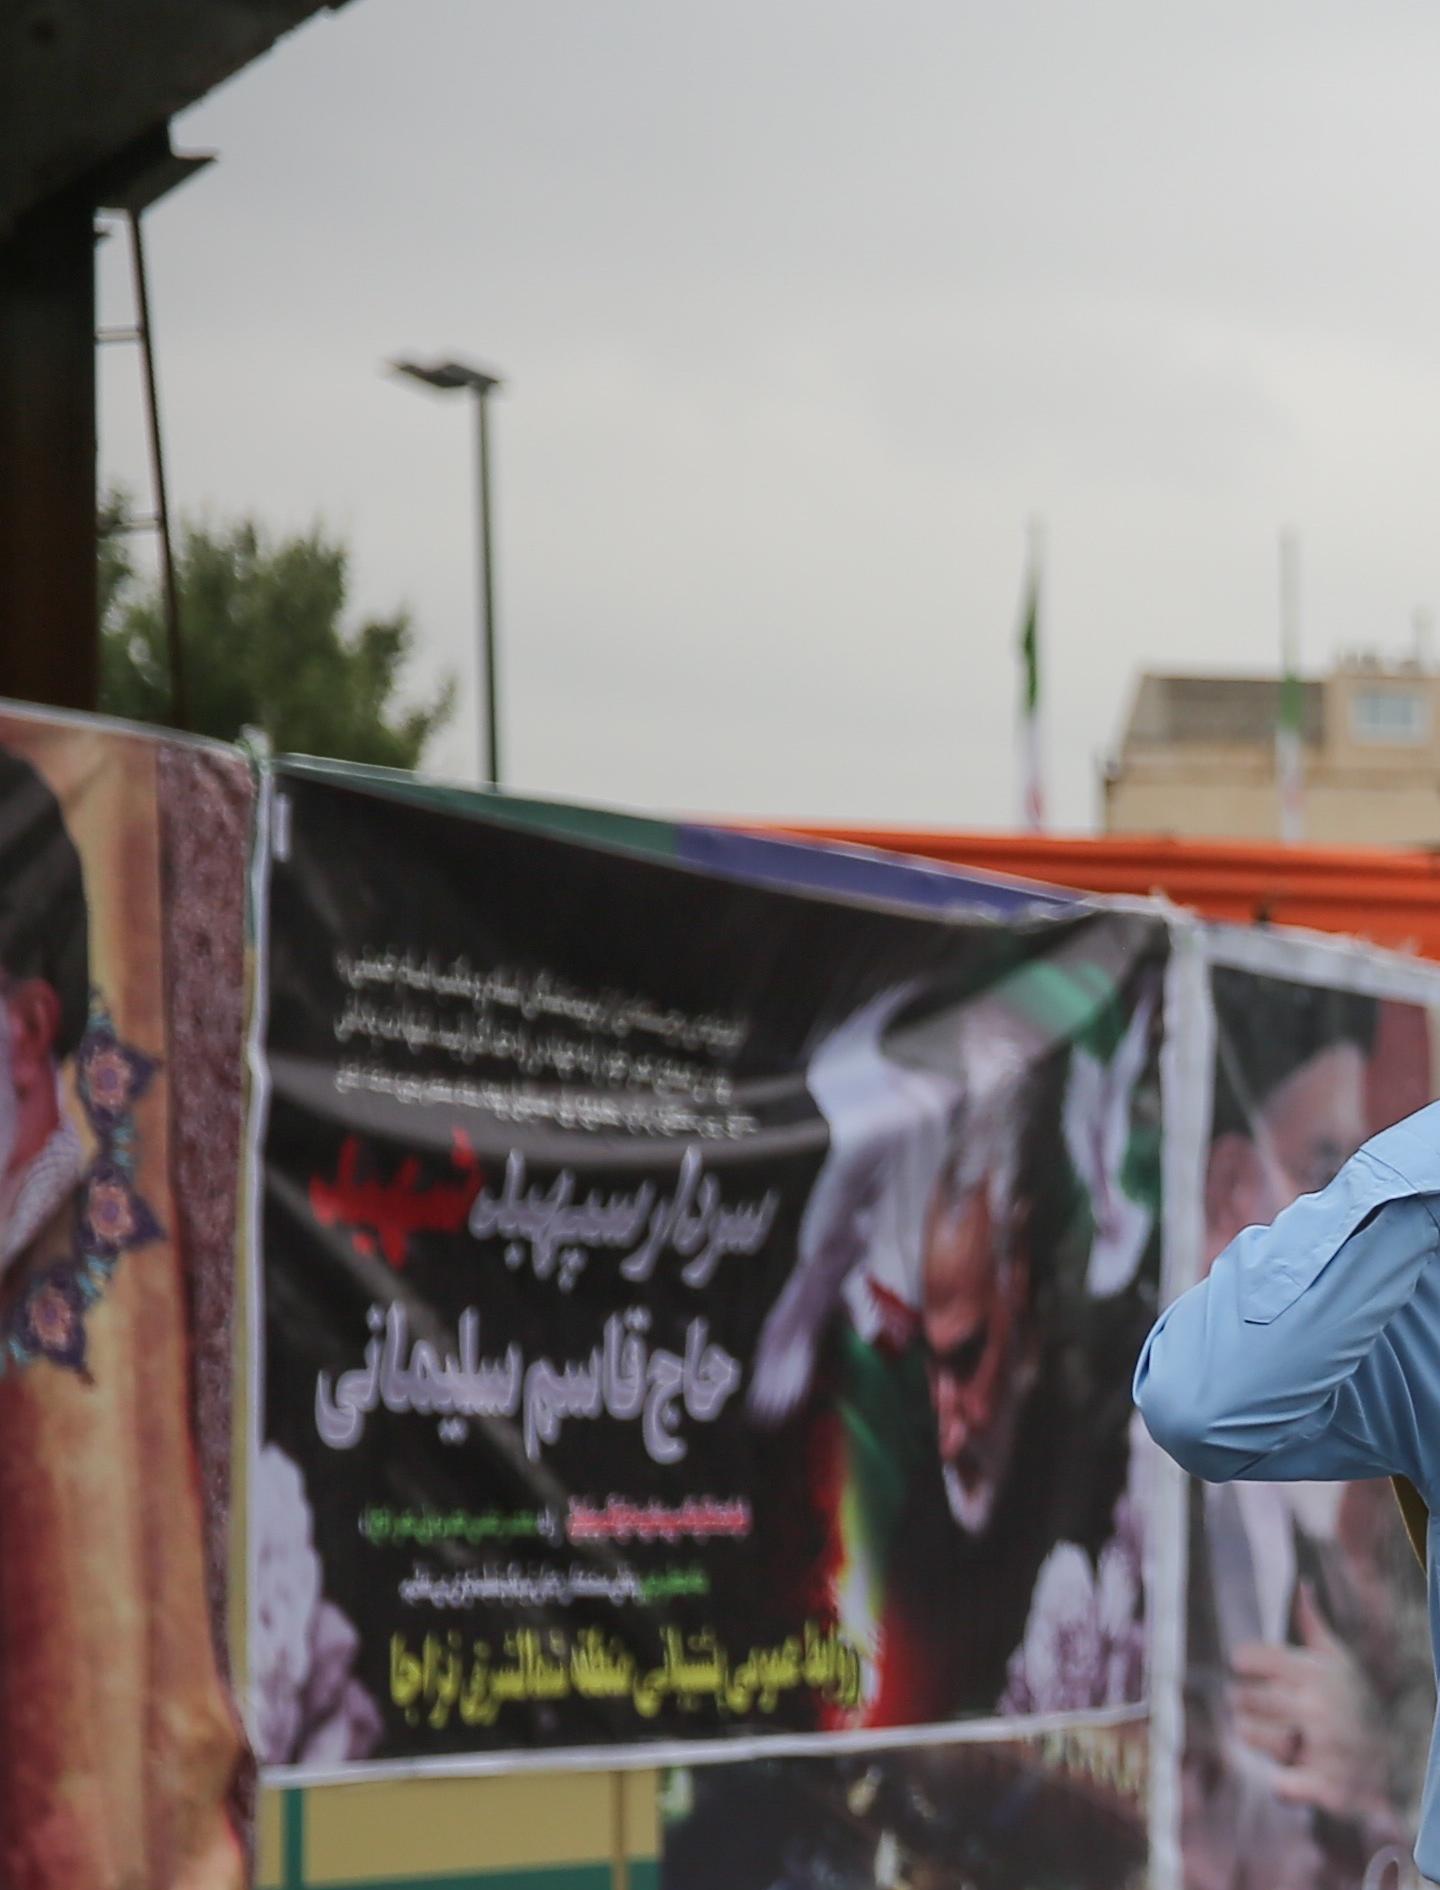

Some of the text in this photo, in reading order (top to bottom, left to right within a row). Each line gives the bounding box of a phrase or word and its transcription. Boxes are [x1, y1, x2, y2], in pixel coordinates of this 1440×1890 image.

[468, 1148, 657, 1294] سپهبد
[620, 1145, 781, 1289] سردار
[314, 1299, 743, 1466] حاج قاسم سلیمانی
